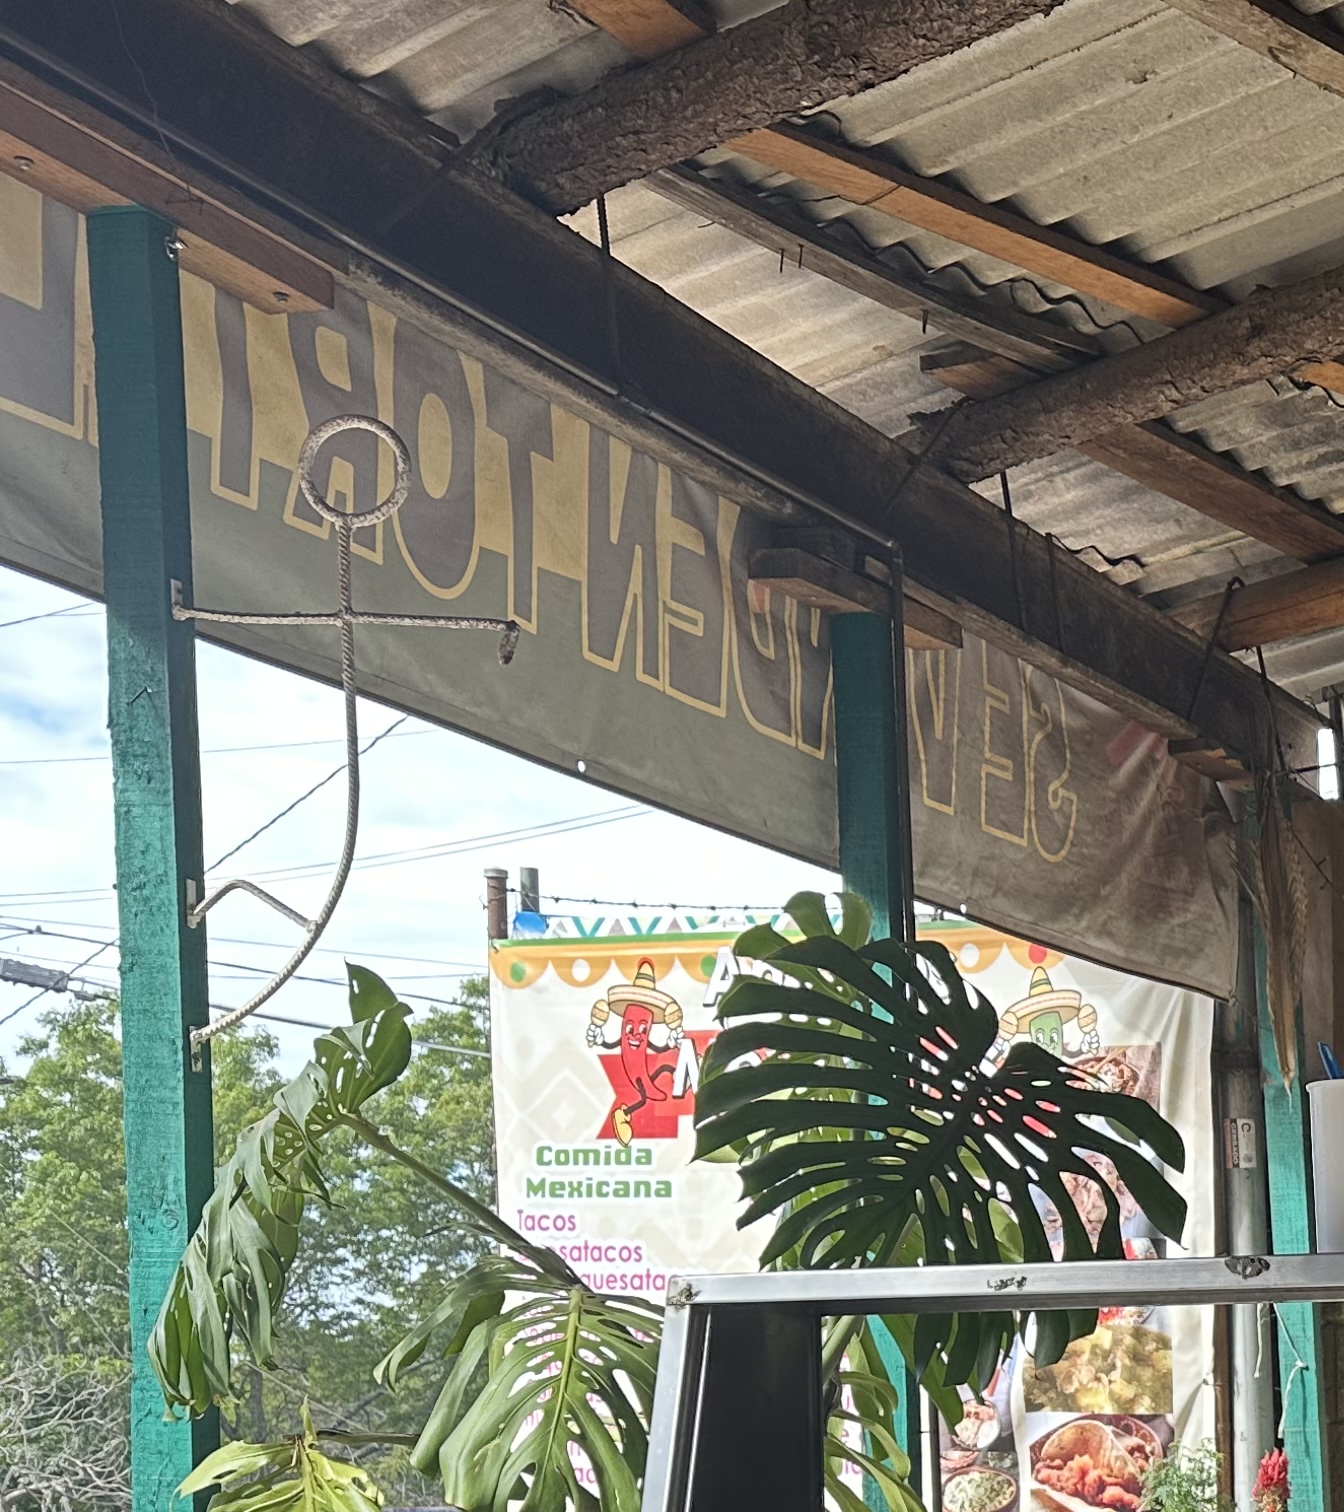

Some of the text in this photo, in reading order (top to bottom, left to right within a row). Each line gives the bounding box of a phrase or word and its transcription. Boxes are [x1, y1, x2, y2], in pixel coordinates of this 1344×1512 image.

[535, 1145, 653, 1167] Comida
[526, 1177, 673, 1199] Mexicana
[517, 1209, 577, 1231] Tacos
